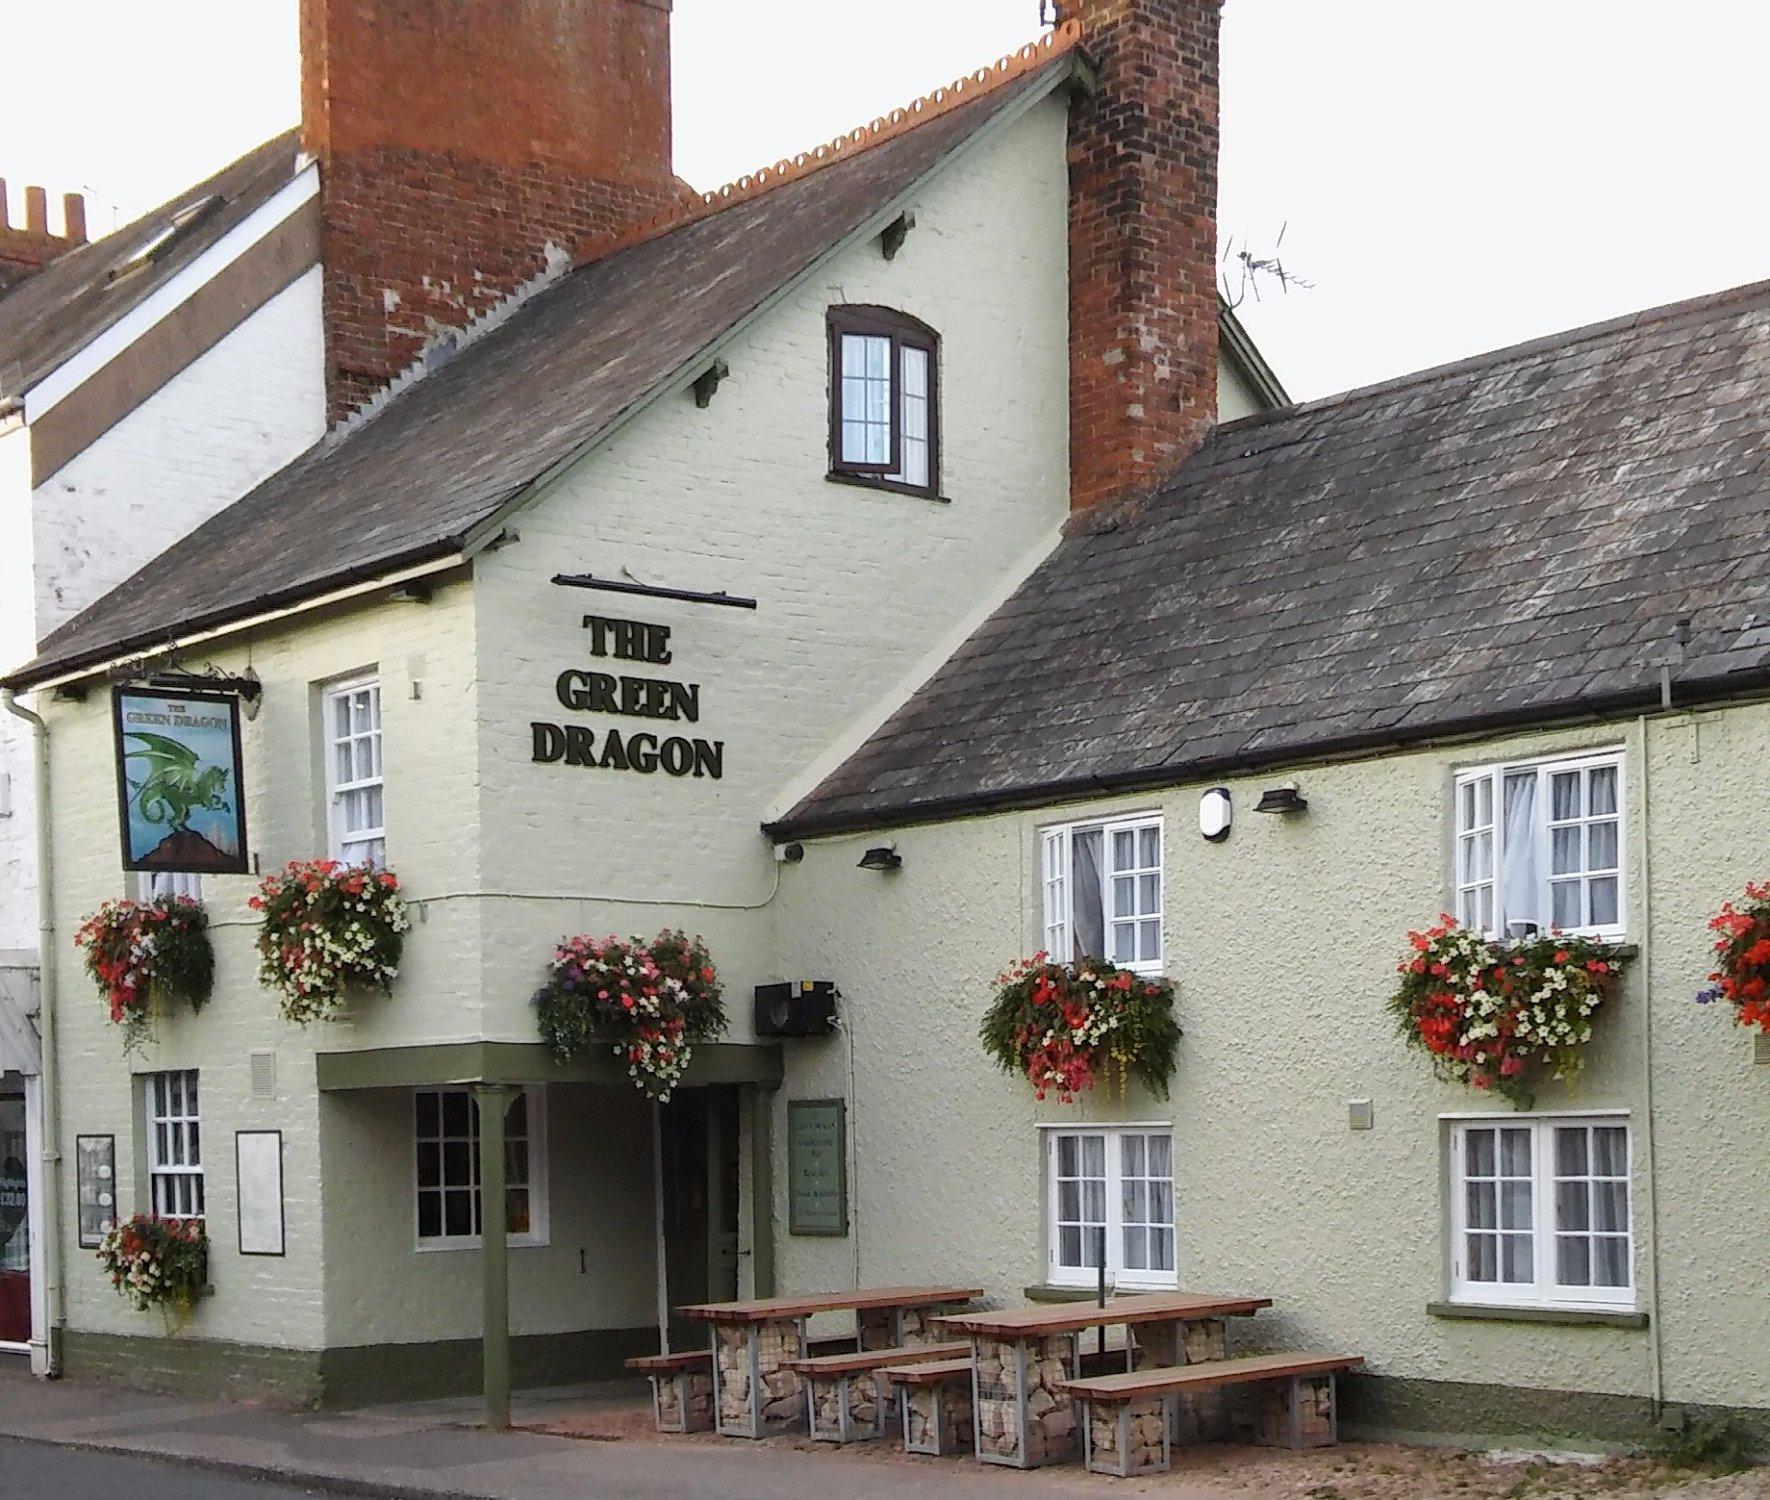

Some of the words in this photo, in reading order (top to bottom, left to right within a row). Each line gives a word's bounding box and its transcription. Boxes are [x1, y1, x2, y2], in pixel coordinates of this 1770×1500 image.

[582, 615, 672, 664] THE
[127, 712, 171, 725] GREEN
[173, 715, 227, 729] DRAGON
[167, 704, 185, 712] THE
[556, 670, 700, 722] GREEN
[531, 722, 724, 778] DRAGON
